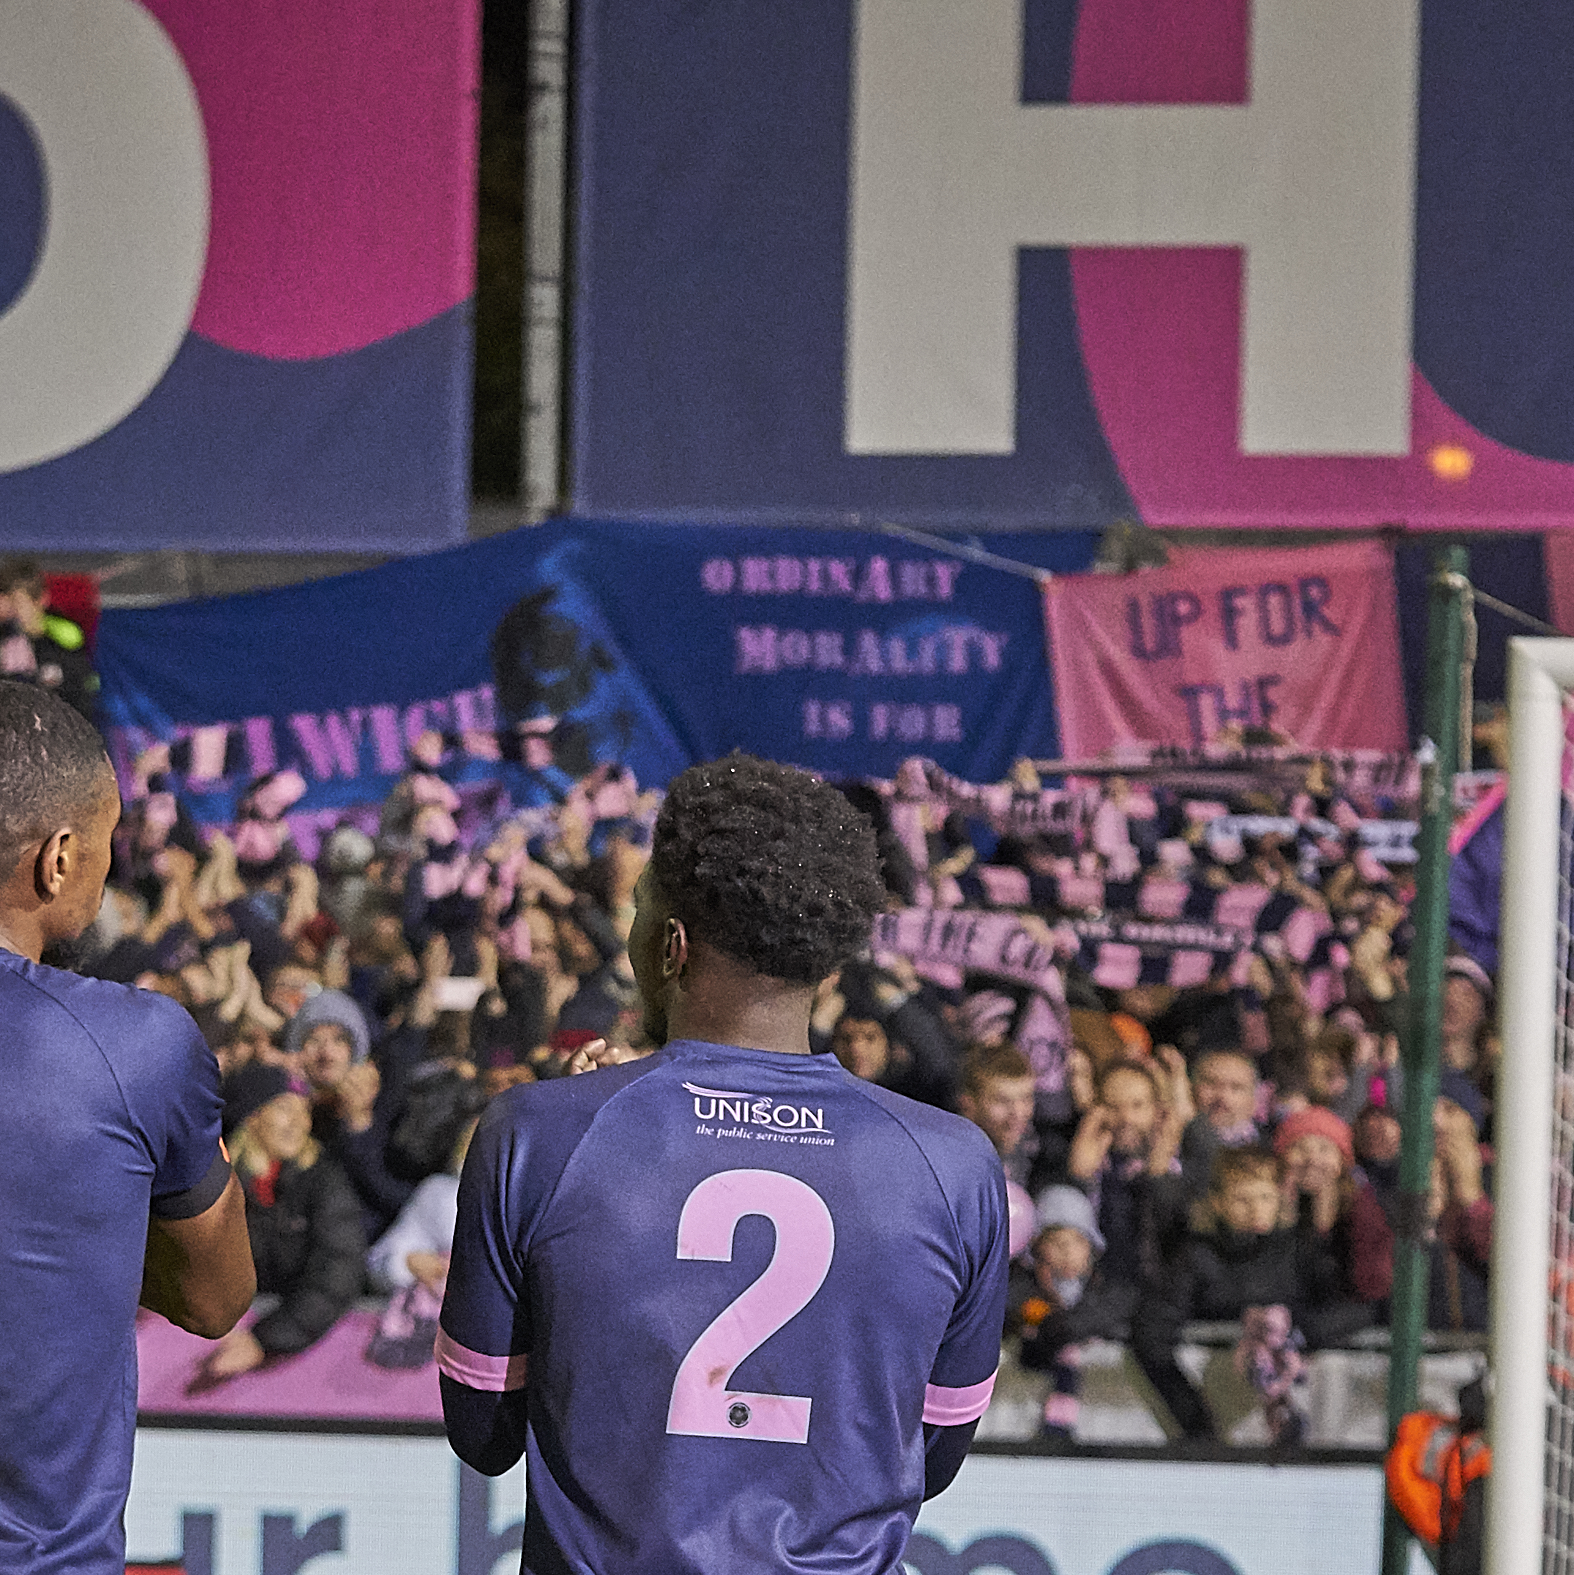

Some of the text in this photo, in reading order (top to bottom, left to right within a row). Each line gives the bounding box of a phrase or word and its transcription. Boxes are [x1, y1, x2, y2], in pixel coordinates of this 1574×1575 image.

[845, 0, 1420, 456] H
[1127, 576, 1342, 661] UP FOR
[801, 699, 964, 743] IS FOR
[1179, 674, 1283, 751] THE
[693, 1096, 824, 1129] UNISON
[695, 1123, 836, 1147] the public service union
[666, 1168, 836, 1445] 2
